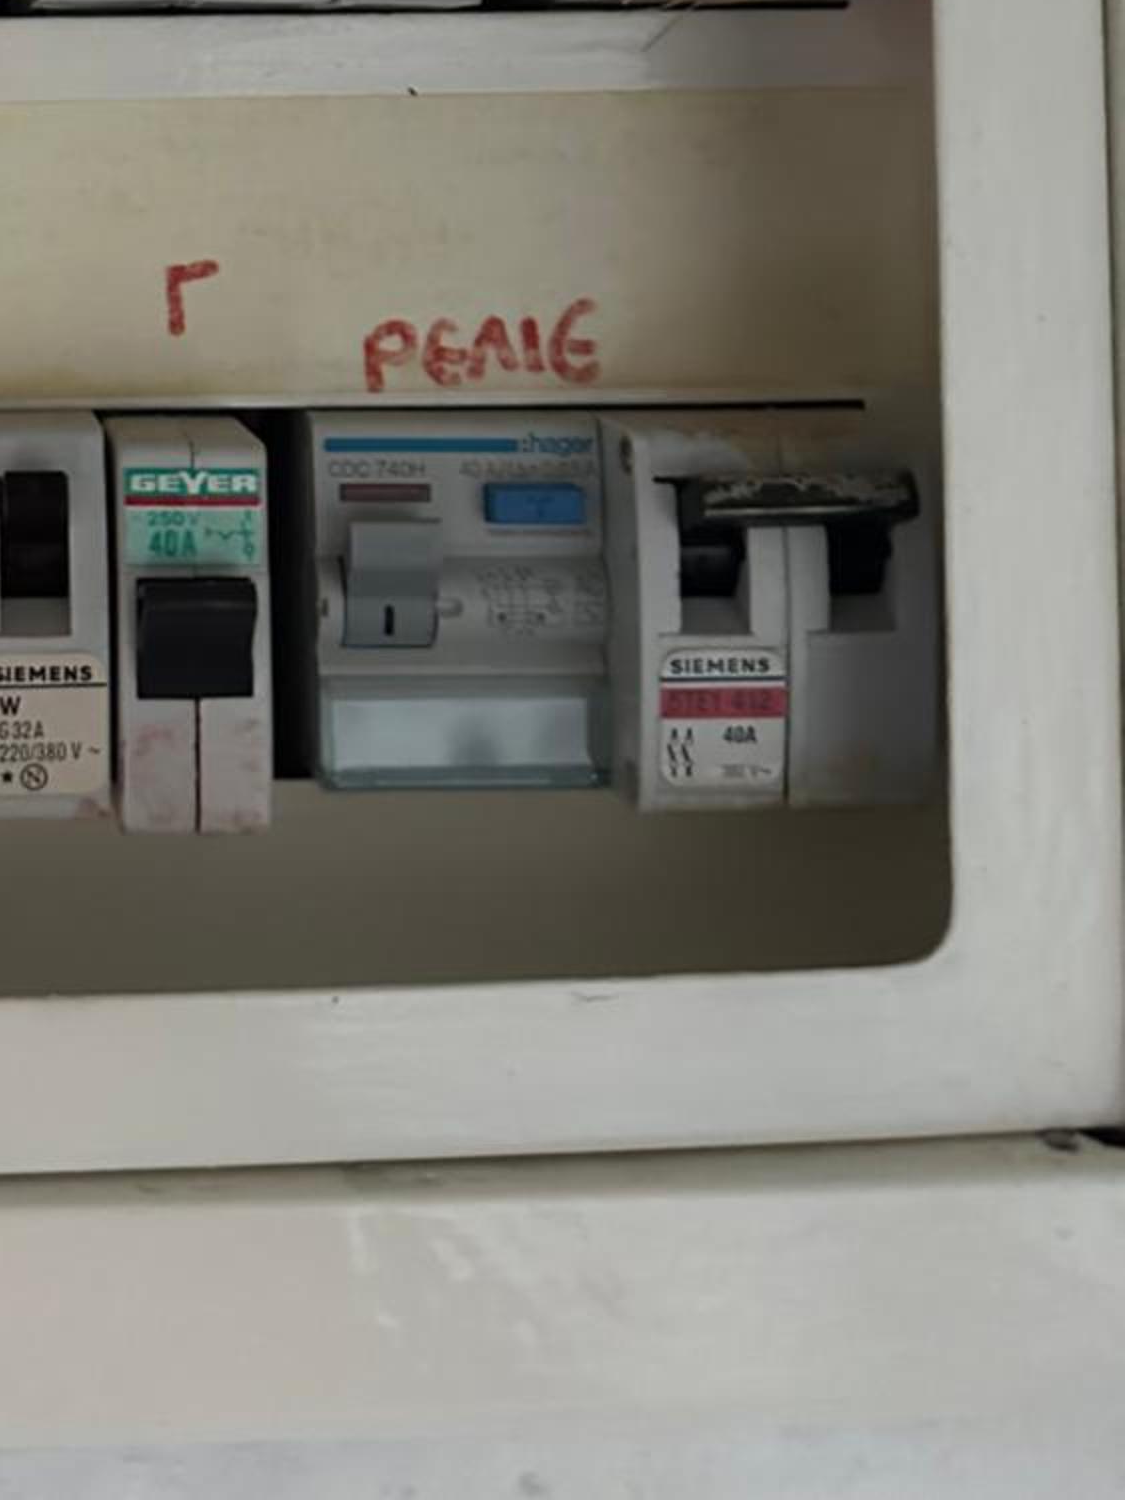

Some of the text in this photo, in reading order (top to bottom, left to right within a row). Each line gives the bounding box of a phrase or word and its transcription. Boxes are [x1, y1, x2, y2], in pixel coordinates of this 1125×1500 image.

[130, 471, 257, 495] GEYER
[148, 528, 198, 557] 40A
[670, 658, 771, 675] SIEMENS
[723, 725, 758, 745] 40A
